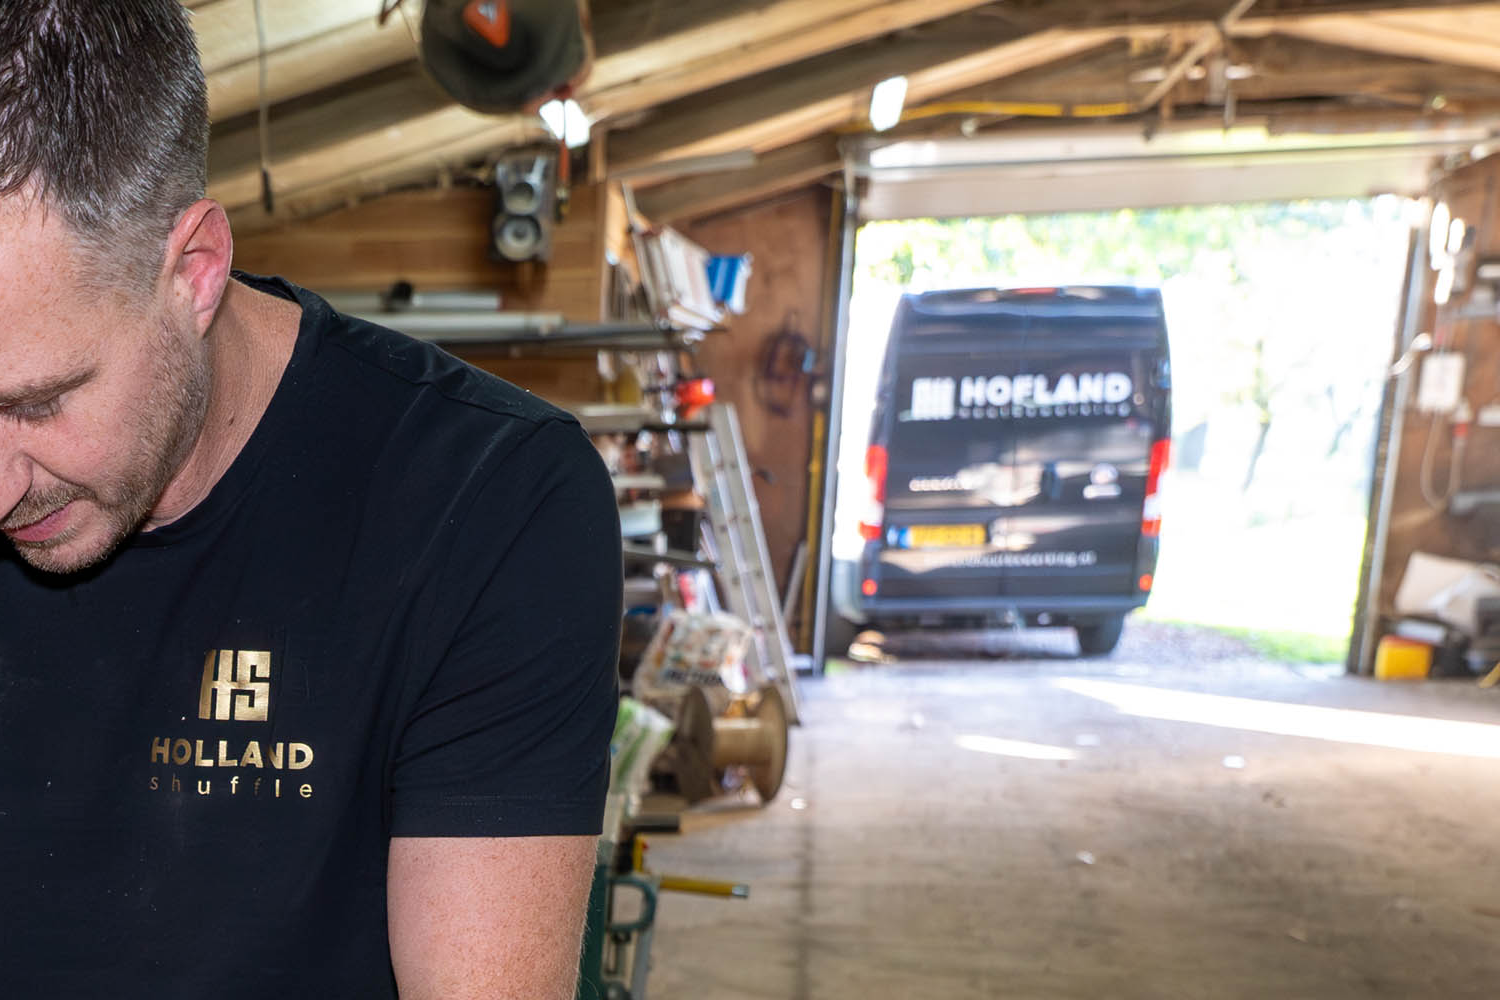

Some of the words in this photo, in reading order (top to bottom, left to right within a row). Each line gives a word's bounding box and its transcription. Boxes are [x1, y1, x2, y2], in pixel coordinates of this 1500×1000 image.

[959, 372, 1133, 407] HOFLAND
[198, 649, 271, 722] HS
[150, 736, 315, 770] HOLLAND
[149, 773, 314, 799] shuffle
